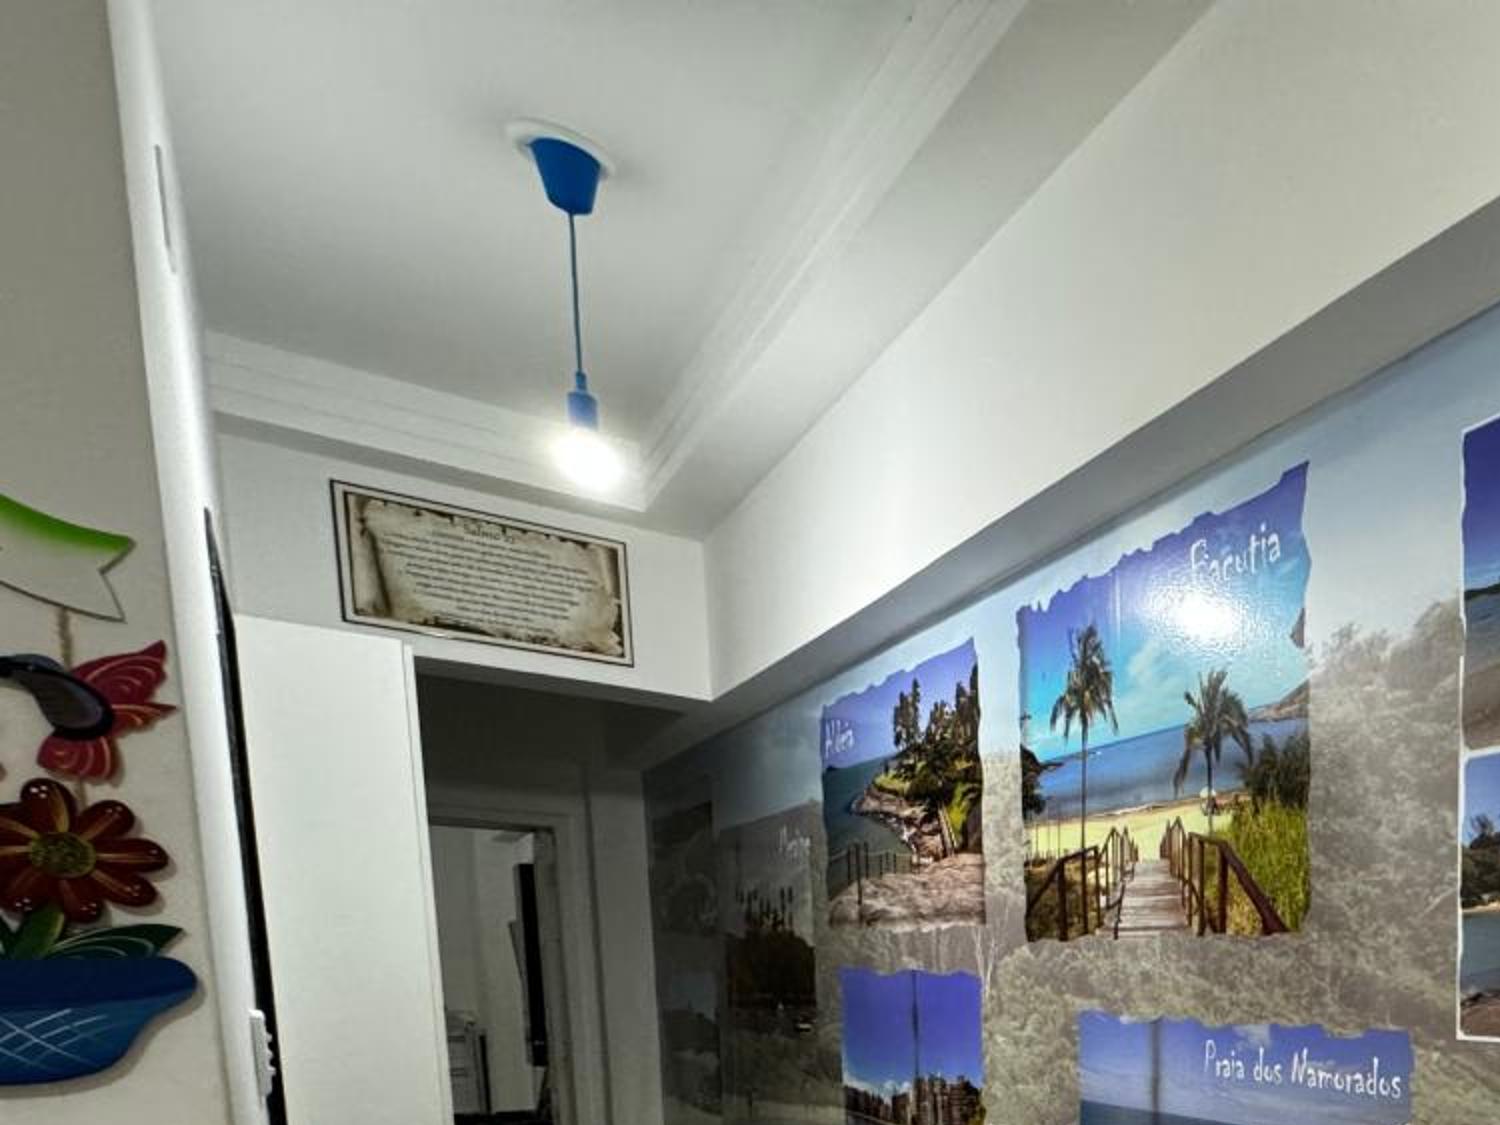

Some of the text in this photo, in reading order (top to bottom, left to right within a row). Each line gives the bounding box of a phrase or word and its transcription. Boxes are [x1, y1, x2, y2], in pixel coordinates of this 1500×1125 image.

[1204, 1039, 1402, 1099] Praia dos Namorados
